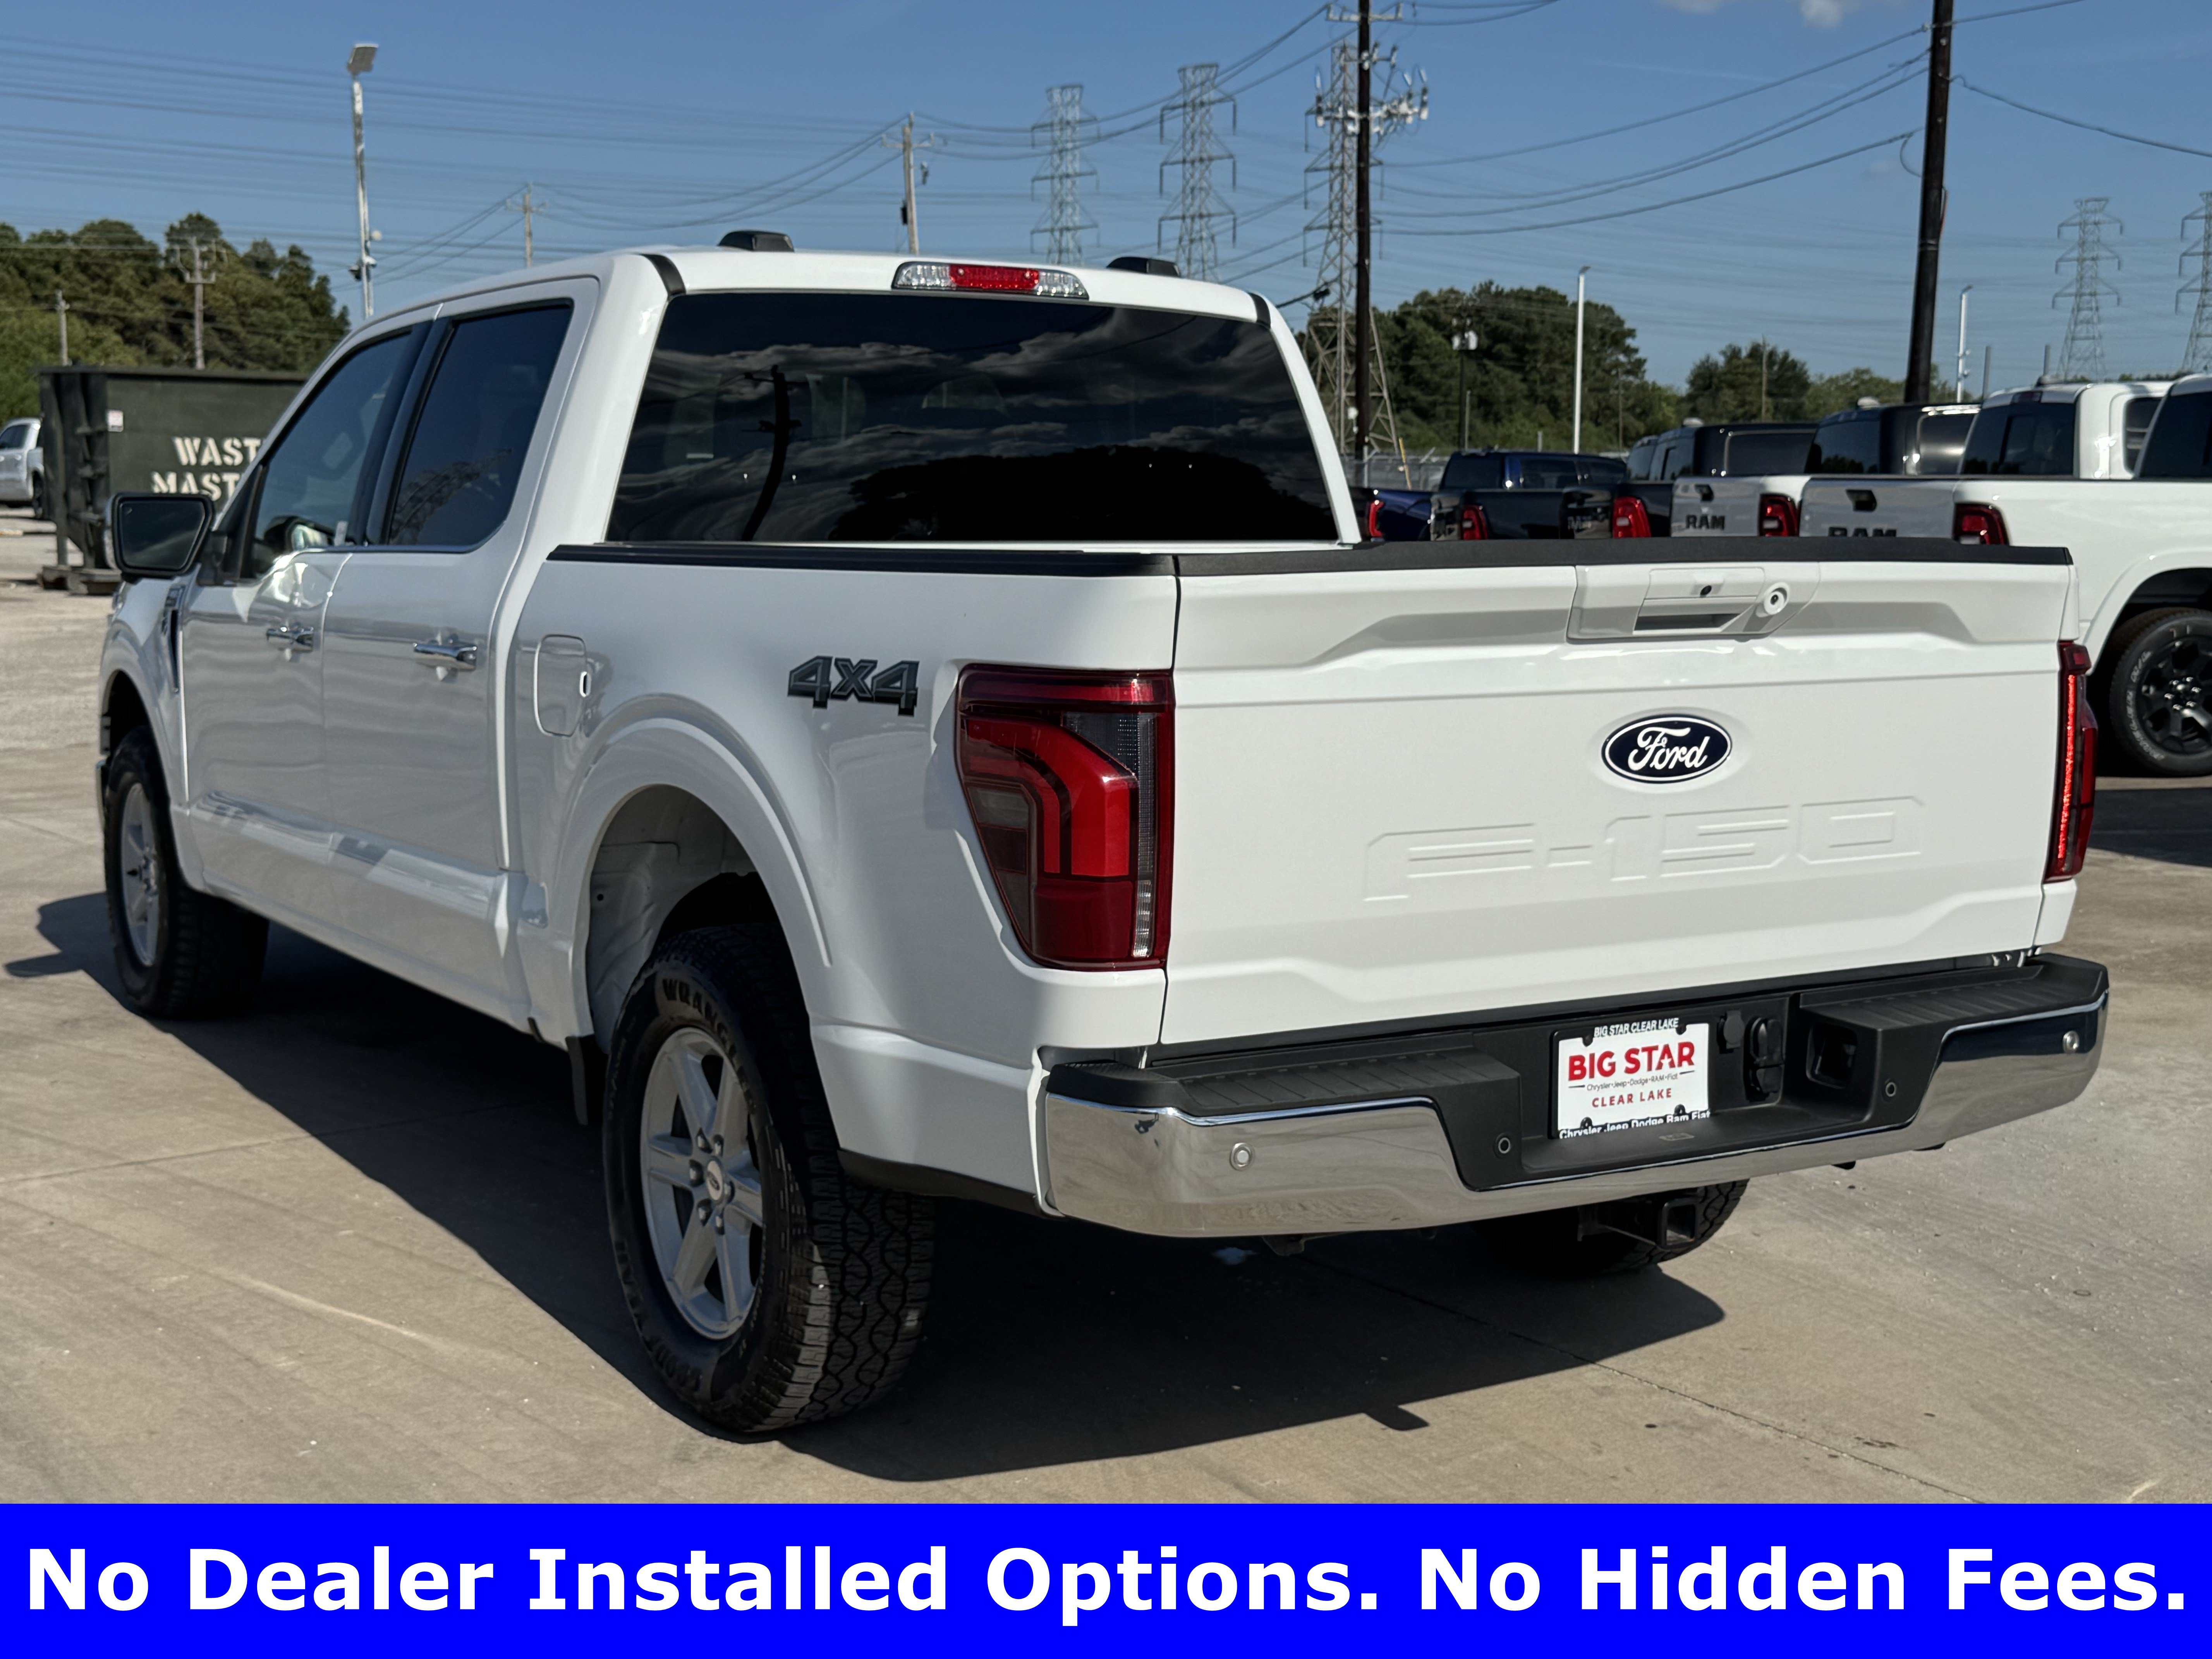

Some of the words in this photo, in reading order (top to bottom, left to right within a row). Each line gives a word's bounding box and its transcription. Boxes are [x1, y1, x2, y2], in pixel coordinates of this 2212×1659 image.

[172, 436, 264, 466] WAST
[151, 471, 241, 501] MAST
[1685, 514, 1725, 531] RAM
[1627, 726, 1710, 771] Ford
[1363, 796, 1925, 901] F-150
[1594, 1025, 1608, 1038] BIG
[1609, 1023, 1630, 1036] STAR
[1631, 1020, 1657, 1033] CLEAR
[1658, 1017, 1679, 1030] LAKE
[1568, 1051, 1616, 1081] BIG
[1624, 1041, 1695, 1074] STAR
[1592, 1092, 1634, 1108] CLEAR
[1640, 1087, 1672, 1102] LAKE
